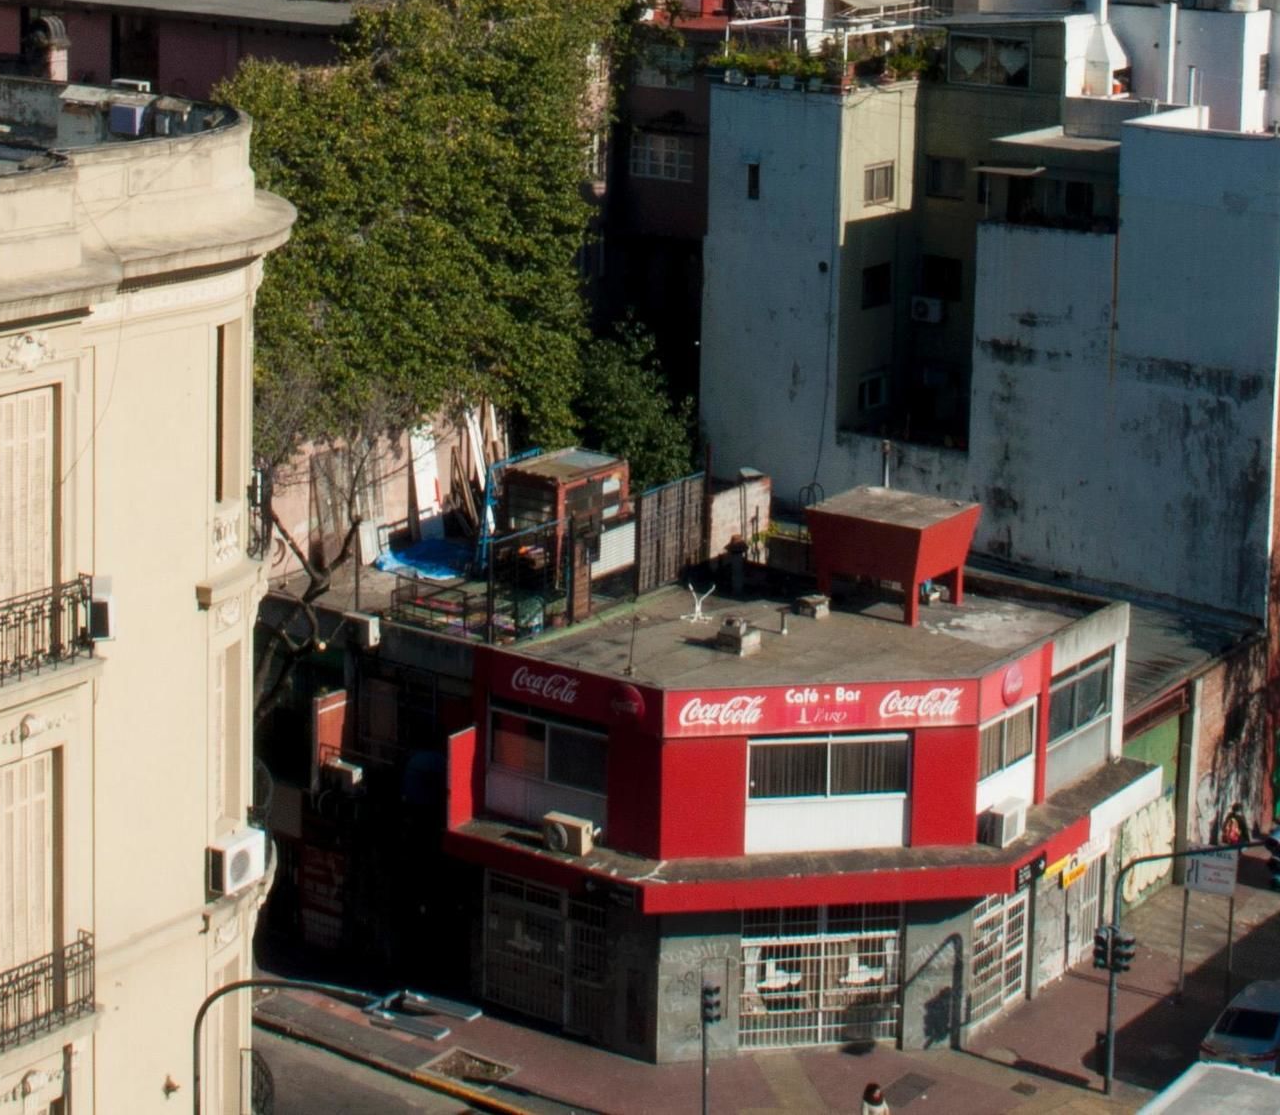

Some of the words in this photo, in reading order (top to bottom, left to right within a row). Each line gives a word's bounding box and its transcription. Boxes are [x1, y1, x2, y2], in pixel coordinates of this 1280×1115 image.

[511, 666, 581, 703] Coca-Cola
[785, 688, 819, 704] Café
[835, 686, 861, 702] Bar
[679, 695, 767, 727] Coca-Cola
[879, 687, 964, 718] Coca-Cola
